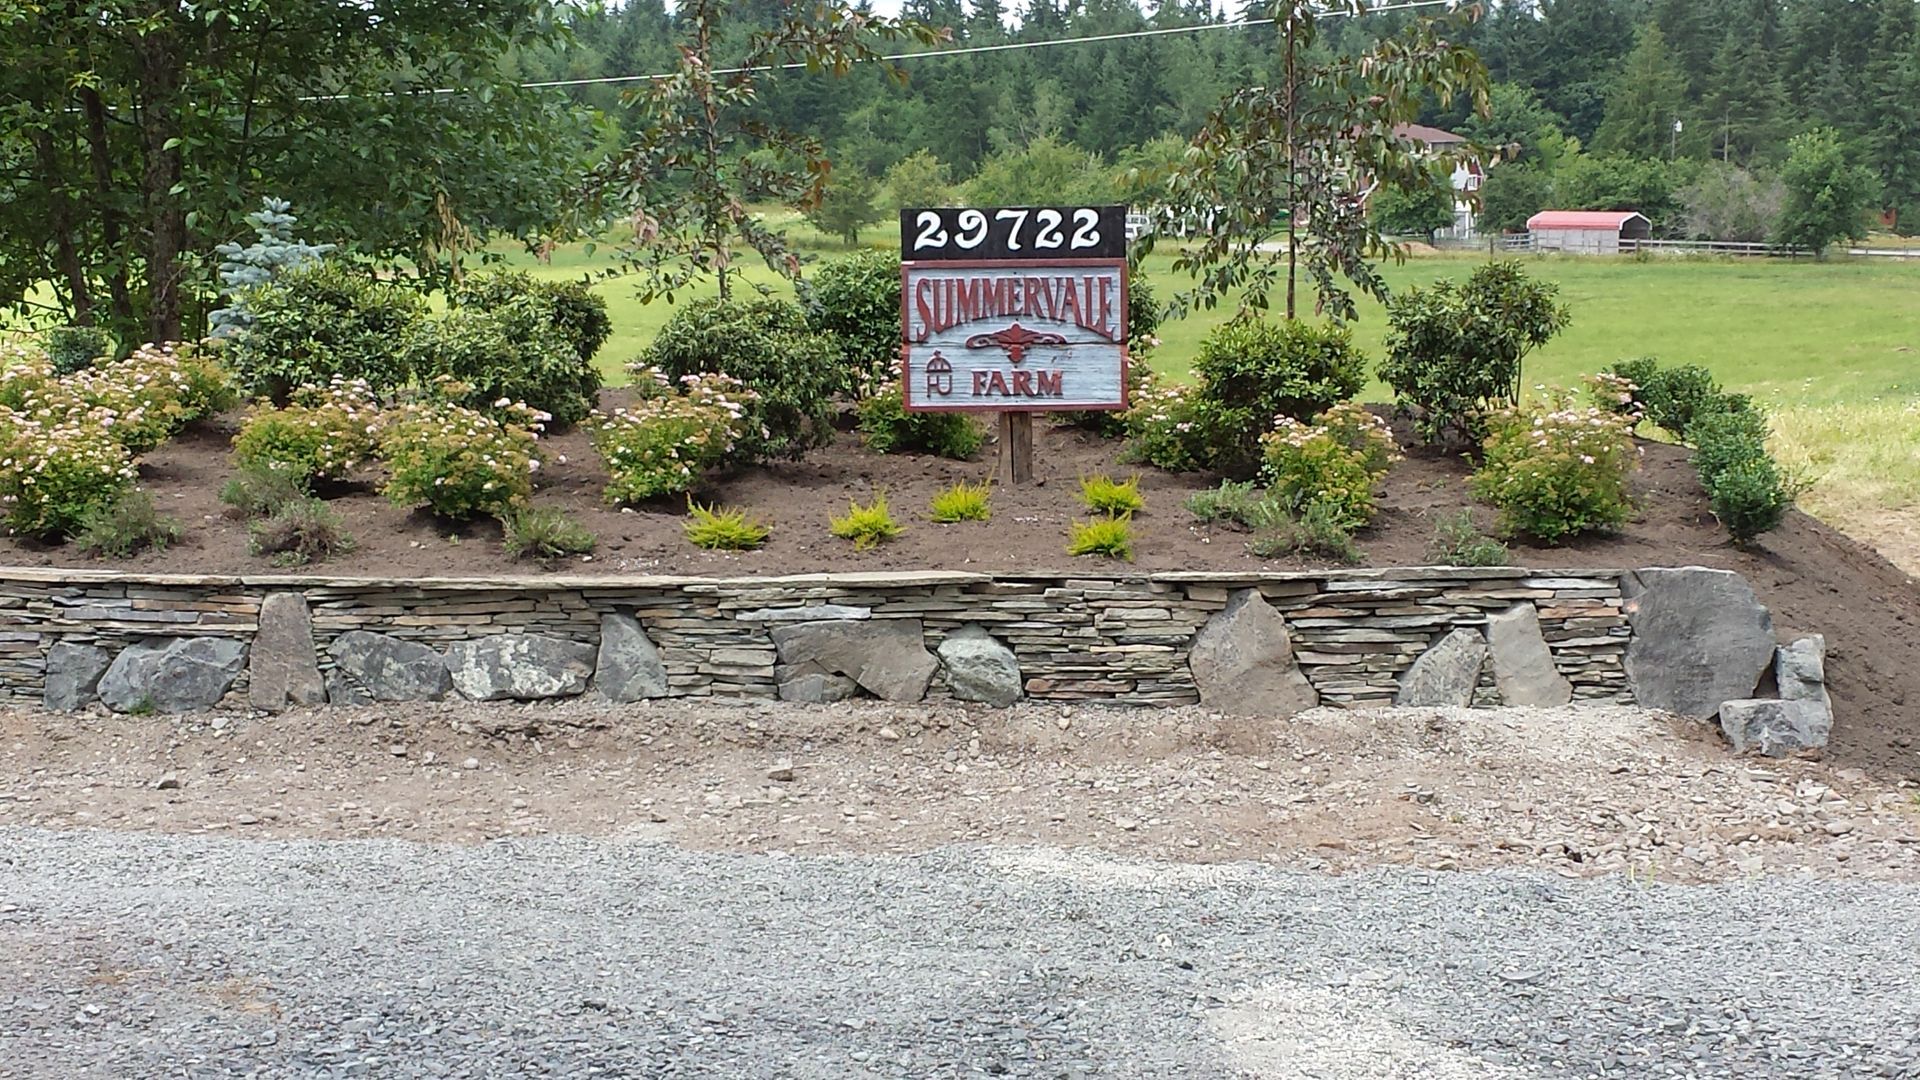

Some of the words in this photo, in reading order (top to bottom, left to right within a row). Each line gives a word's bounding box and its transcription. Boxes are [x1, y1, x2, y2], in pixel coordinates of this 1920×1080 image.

[914, 208, 1101, 251] 29722
[916, 276, 1116, 342] SUMMERVALE
[971, 369, 1064, 397] FARM
